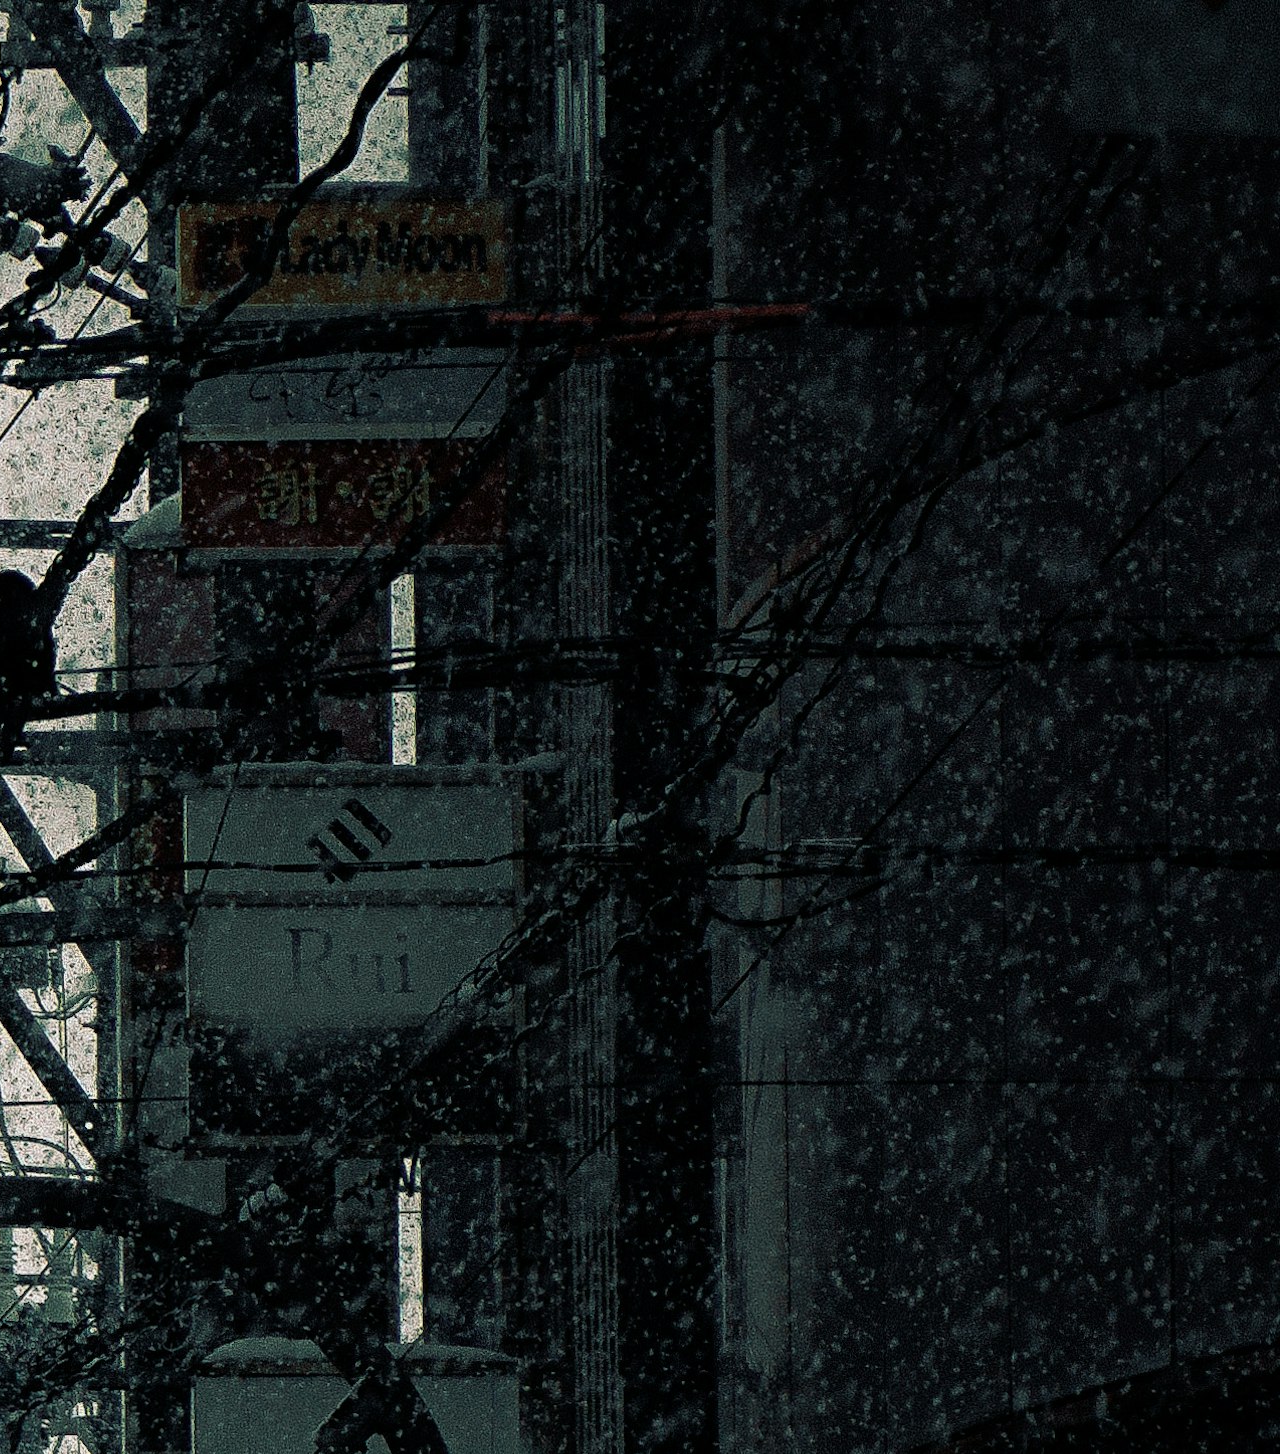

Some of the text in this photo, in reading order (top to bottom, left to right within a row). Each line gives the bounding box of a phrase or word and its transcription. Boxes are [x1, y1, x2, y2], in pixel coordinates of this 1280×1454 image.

[280, 219, 488, 280] Lady Moon
[287, 926, 417, 994] Rui
